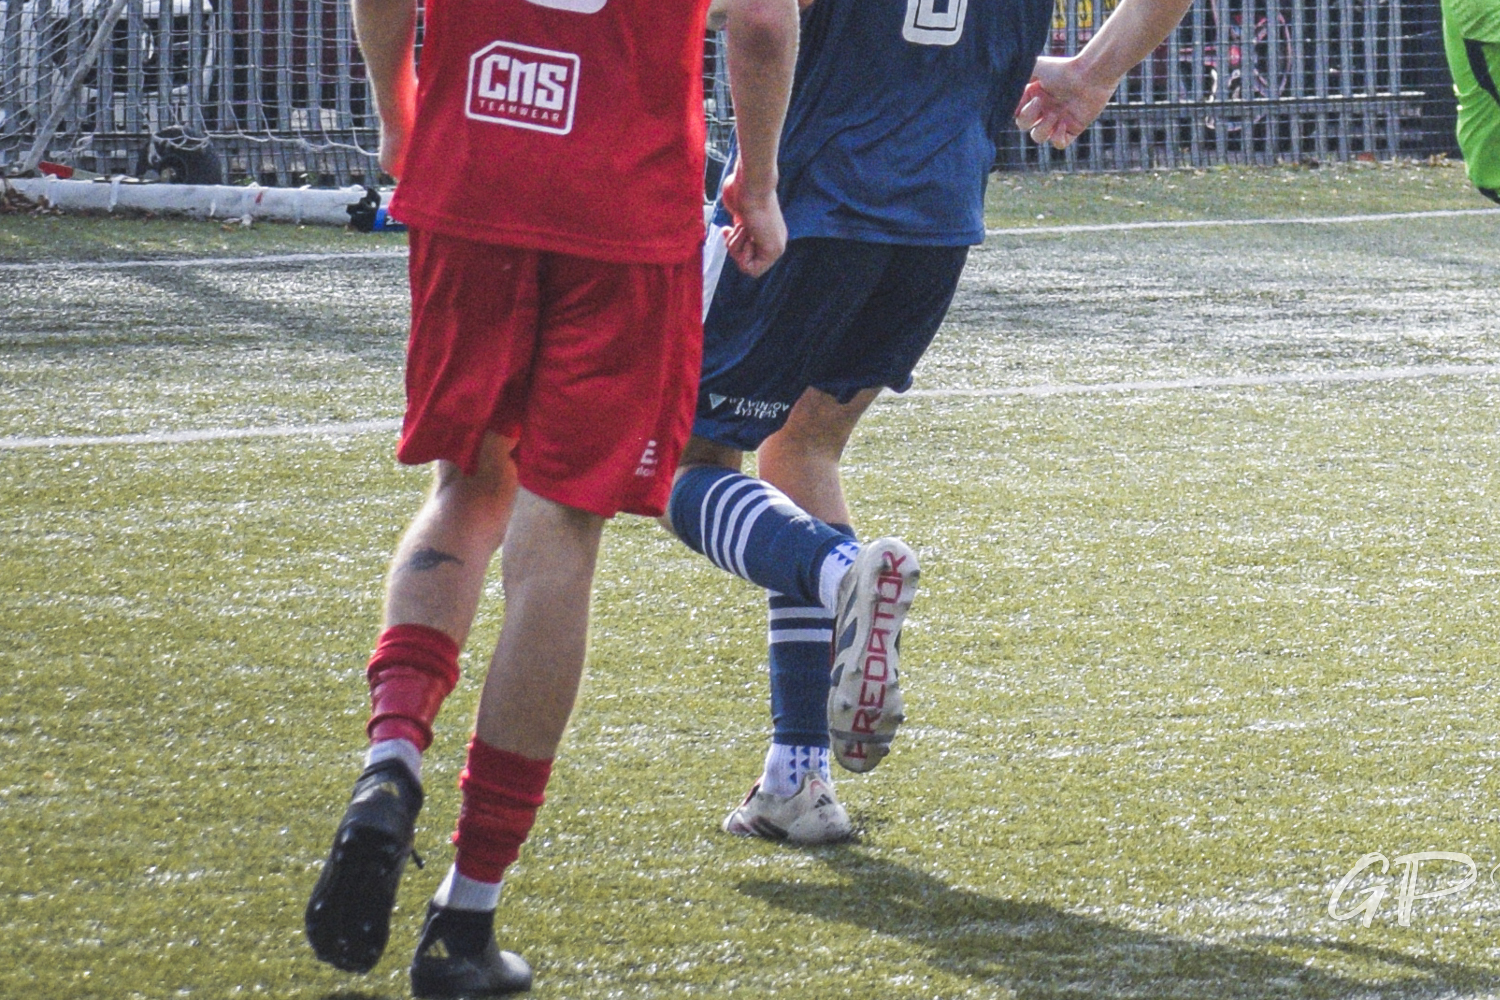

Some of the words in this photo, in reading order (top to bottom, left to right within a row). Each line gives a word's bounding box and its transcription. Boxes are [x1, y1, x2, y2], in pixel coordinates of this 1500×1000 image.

[478, 53, 568, 111] CMS
[478, 99, 561, 122] TEAMWEAR
[843, 551, 906, 760] PREDATOR
